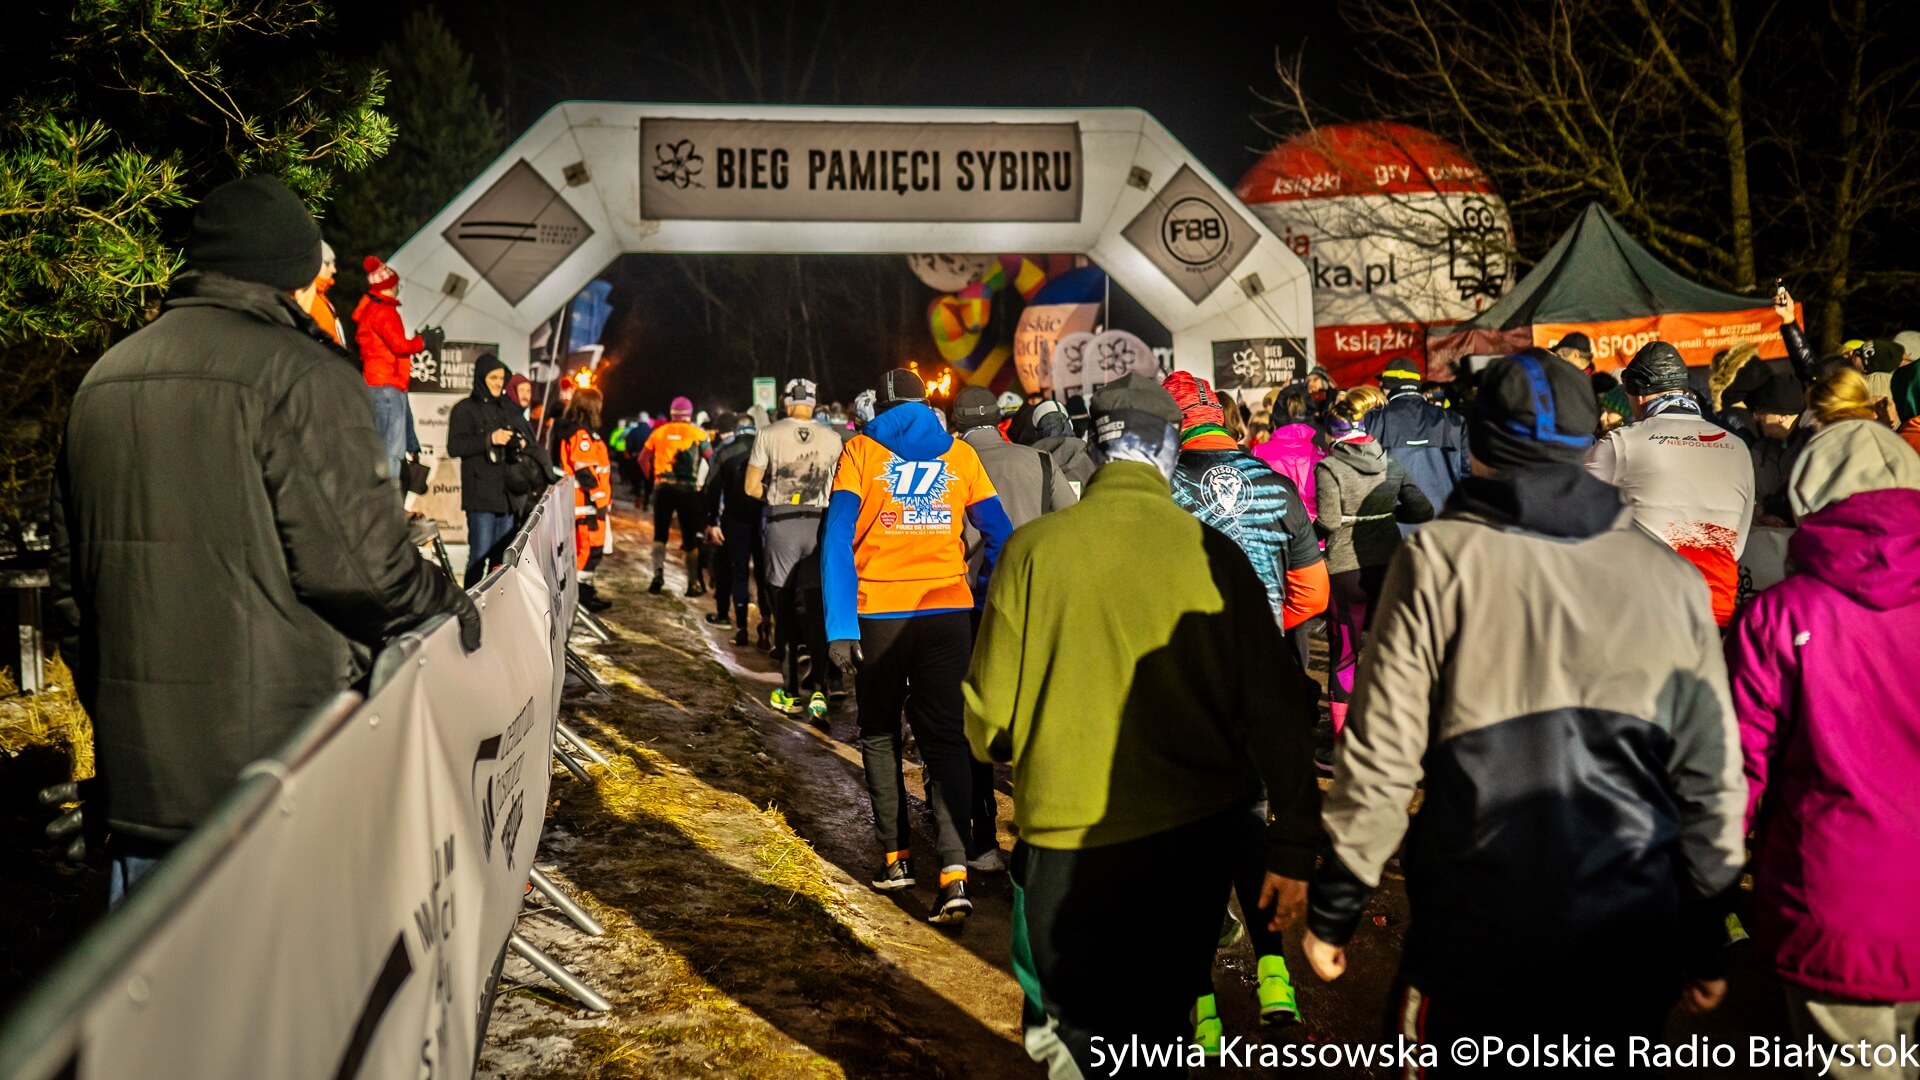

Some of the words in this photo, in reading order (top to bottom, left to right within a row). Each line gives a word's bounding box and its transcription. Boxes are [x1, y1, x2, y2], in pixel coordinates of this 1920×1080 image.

[717, 147, 789, 189] BIEG
[808, 149, 941, 196] PAMIĘCI
[956, 150, 1072, 192] SYBIRU
[1271, 172, 1342, 197] książki
[1373, 164, 1411, 187] gry
[1334, 328, 1415, 355] książki
[440, 362, 476, 377] PAMIĘC
[895, 461, 943, 495] 17
[1211, 466, 1239, 477] BISON
